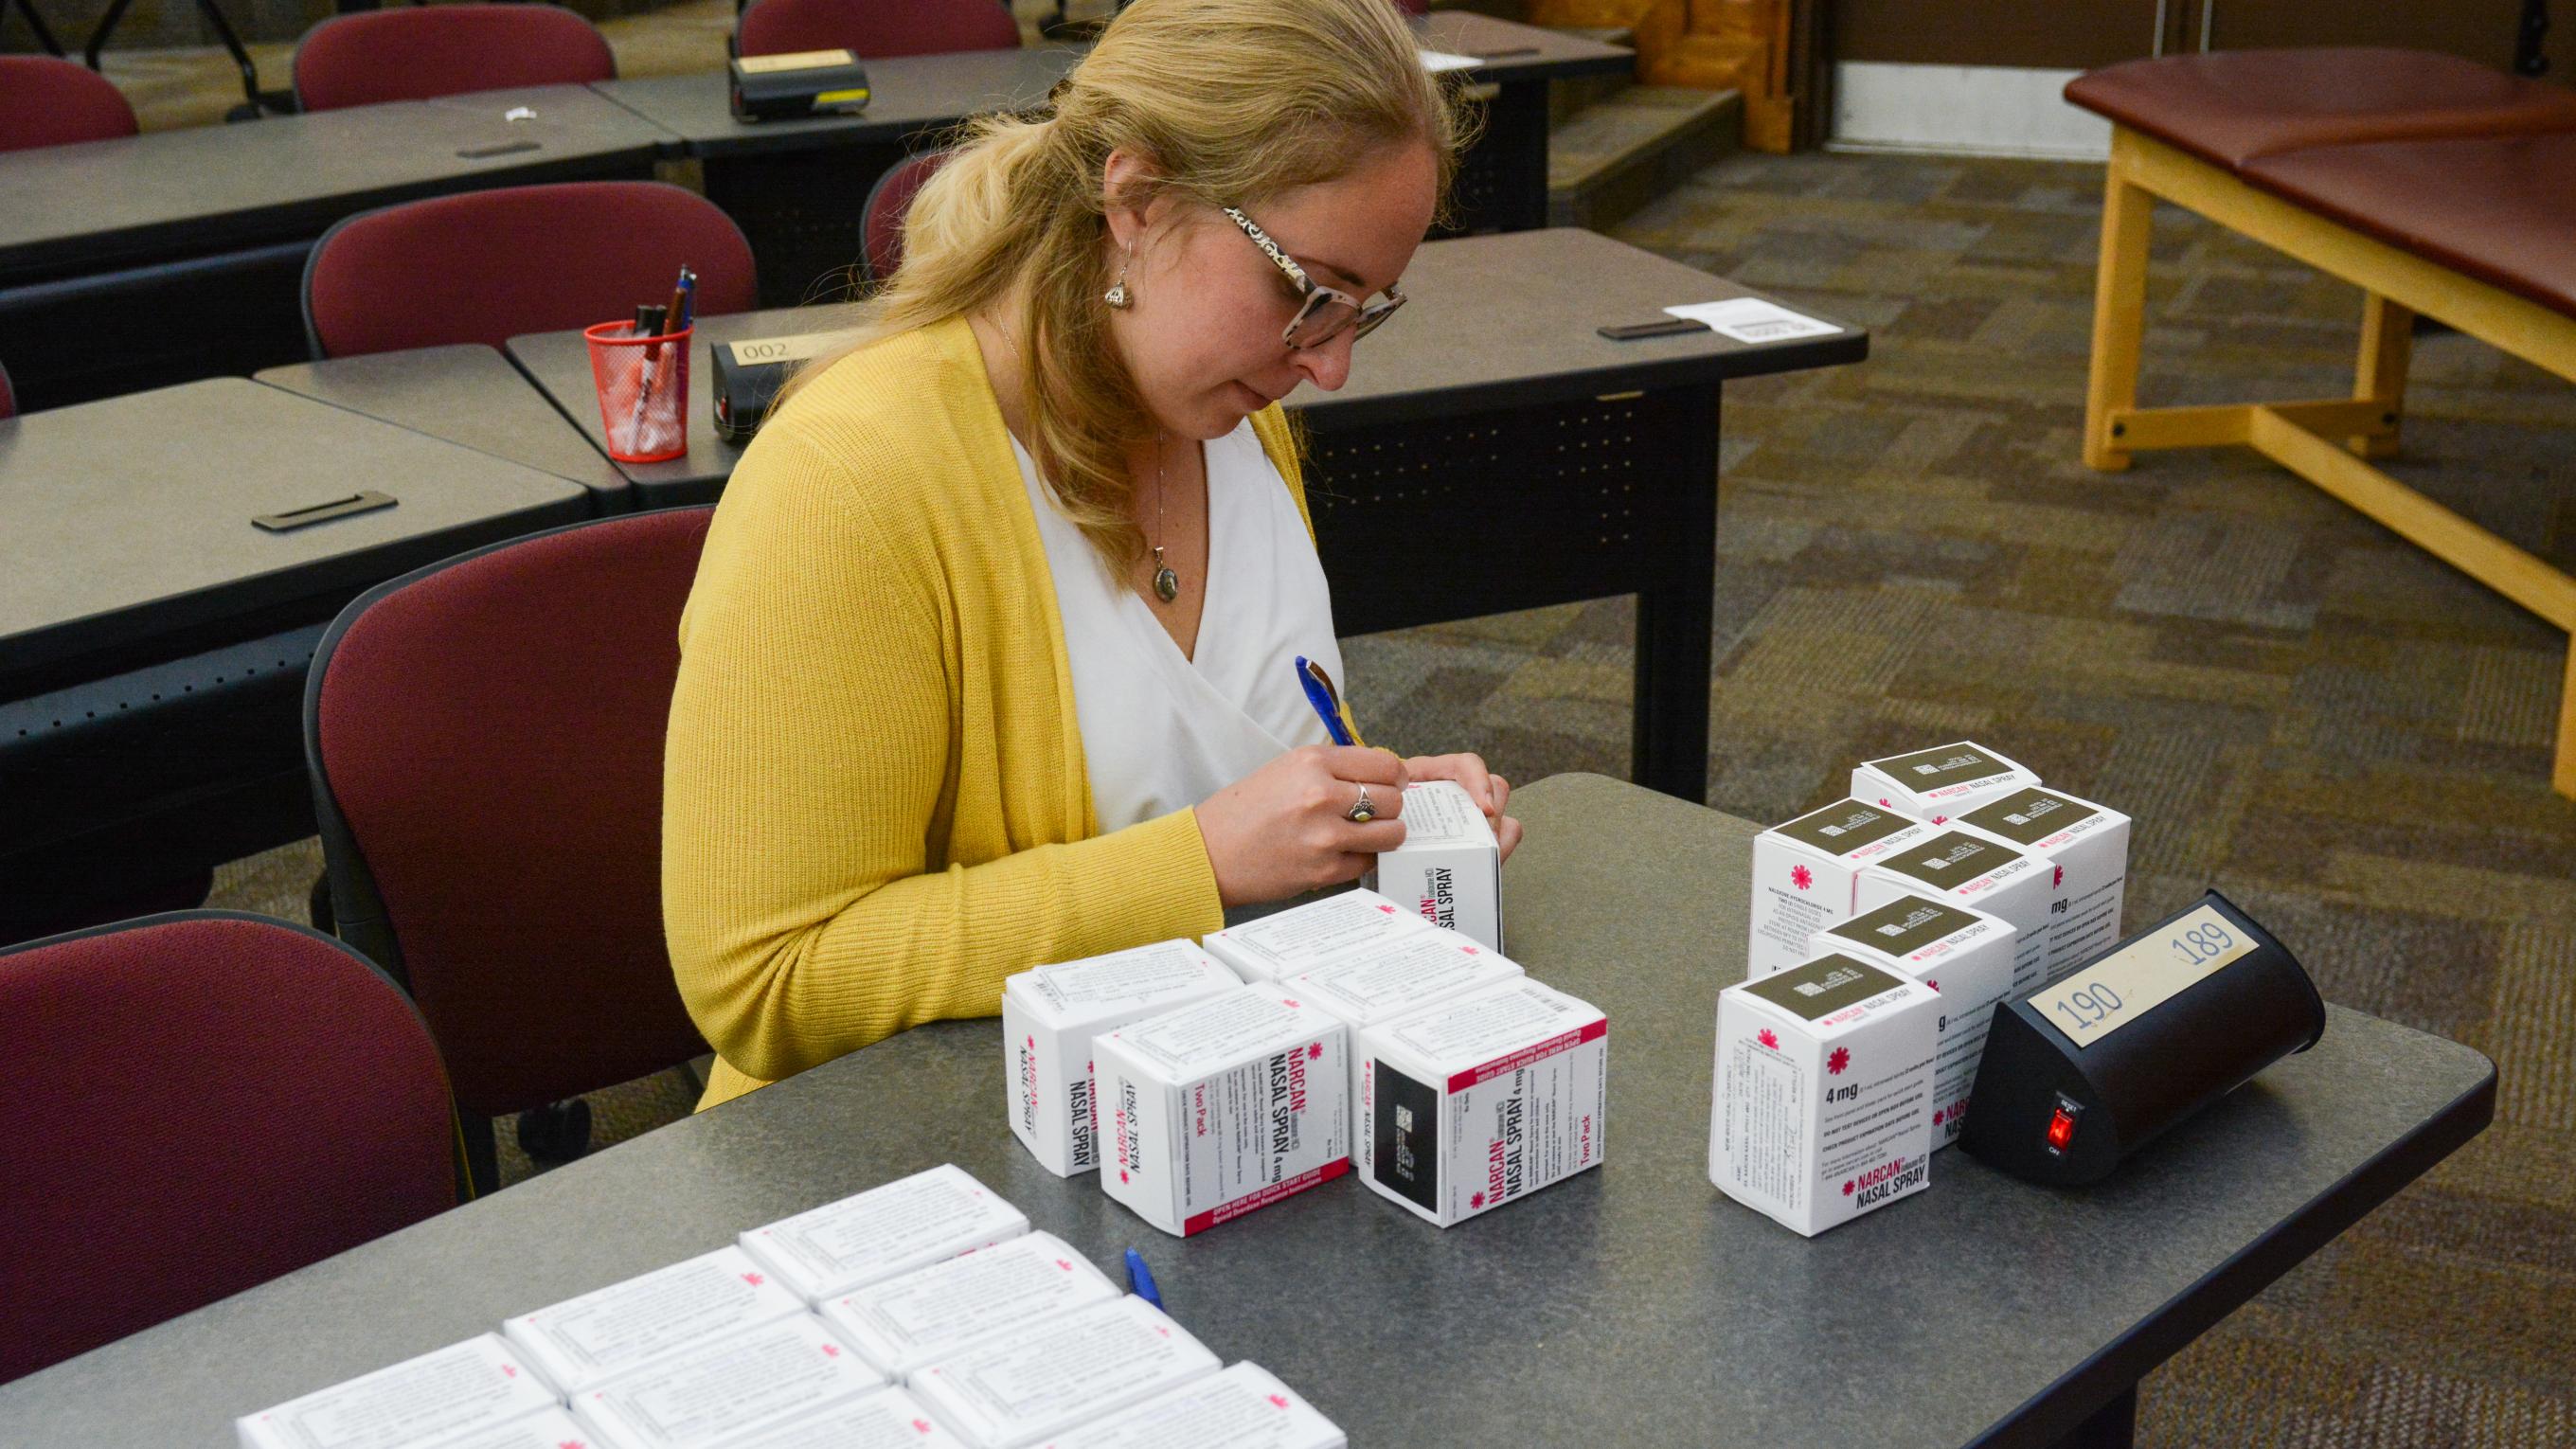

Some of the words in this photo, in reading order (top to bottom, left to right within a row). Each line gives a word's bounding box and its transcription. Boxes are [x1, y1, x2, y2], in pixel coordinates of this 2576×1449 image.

[742, 342, 788, 360] 002
[1939, 784, 1969, 797] NARCAN
[1970, 779, 1992, 790] NASAL
[1992, 774, 2015, 784] SPRAY
[2068, 823, 2088, 834] NASAL
[2086, 815, 2106, 827] SPRAY
[1991, 868, 2012, 881] NASAL
[2011, 859, 2030, 872] SPRAY
[1436, 868, 1454, 904] SPRAY
[2051, 896, 2067, 918] mg
[1947, 932, 1969, 946] NASAL
[1967, 924, 1990, 937] SPRAY
[2172, 922, 2233, 966] 189
[1864, 997, 1890, 1011] NASAL
[1889, 989, 1913, 1002] SPRAY
[2057, 982, 2123, 1029] 190
[1536, 1049, 1547, 1061] FOR
[1548, 1043, 1563, 1055] HERE
[1564, 1036, 1580, 1049] OPEN
[1020, 1046, 1029, 1088] NASAL
[1496, 1062, 1514, 1076] START
[1516, 1054, 1534, 1068] QUICK
[1269, 1052, 1287, 1106] NASAL
[1476, 1069, 1494, 1083] GUIDE
[1514, 1067, 1524, 1087] mg
[1069, 1081, 1088, 1125] NASAL
[1125, 1080, 1137, 1126] SPRAY
[1195, 1082, 1205, 1108] Two
[1512, 1087, 1522, 1096] 4
[1825, 1087, 1834, 1106] 4
[1836, 1081, 1858, 1106] mg
[1023, 1090, 1032, 1136] SPRAY
[1196, 1107, 1206, 1137] Pack
[1506, 1093, 1522, 1146] SPRAY
[1116, 1109, 1129, 1166] NARCAN
[1271, 1105, 1288, 1157] SPRAY
[1581, 1113, 1590, 1142] Pack
[1073, 1125, 1090, 1167] SPRAY
[1129, 1131, 1141, 1173] NASAL
[1273, 1154, 1281, 1163] 4
[1581, 1141, 1589, 1165] Two
[1271, 1163, 1281, 1183] mg
[1506, 1144, 1521, 1197] NASAL
[1213, 1201, 1231, 1216] OPEN
[1232, 1195, 1246, 1208] HERE
[1248, 1190, 1261, 1202] FOR
[1261, 1183, 1280, 1197] QUICK
[1281, 1175, 1300, 1189] START
[1301, 1168, 1320, 1181] GUIDE
[1857, 1180, 1891, 1209] NASAL
[1892, 1164, 1924, 1194] SPRAY
